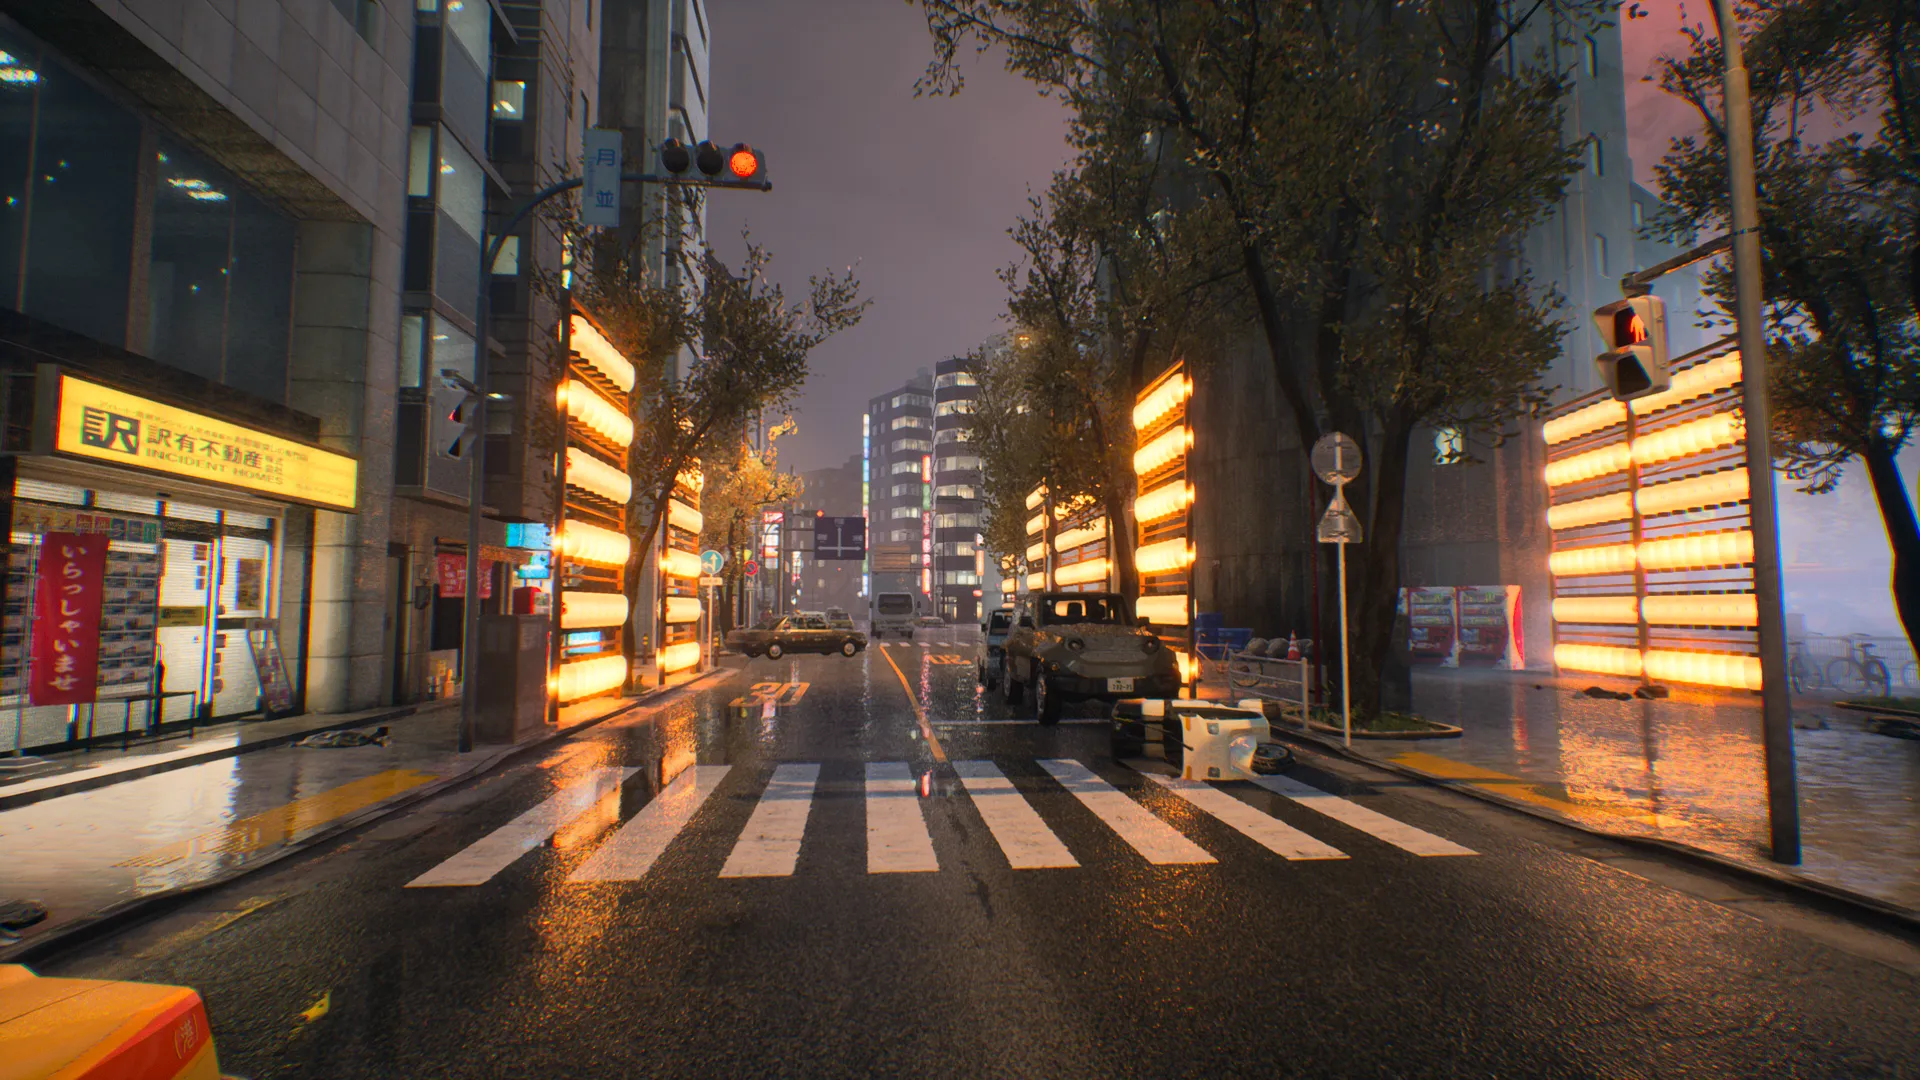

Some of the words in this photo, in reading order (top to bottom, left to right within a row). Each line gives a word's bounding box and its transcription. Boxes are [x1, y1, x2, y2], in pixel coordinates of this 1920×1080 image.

[596, 148, 615, 208] 月並
[81, 405, 140, 456] 訳
[147, 424, 262, 469] 訳有不動産
[146, 448, 226, 473] INCIDENT
[232, 467, 284, 485] HOMES
[48, 545, 87, 691] いらっしゃいませ
[728, 682, 810, 707] 30
